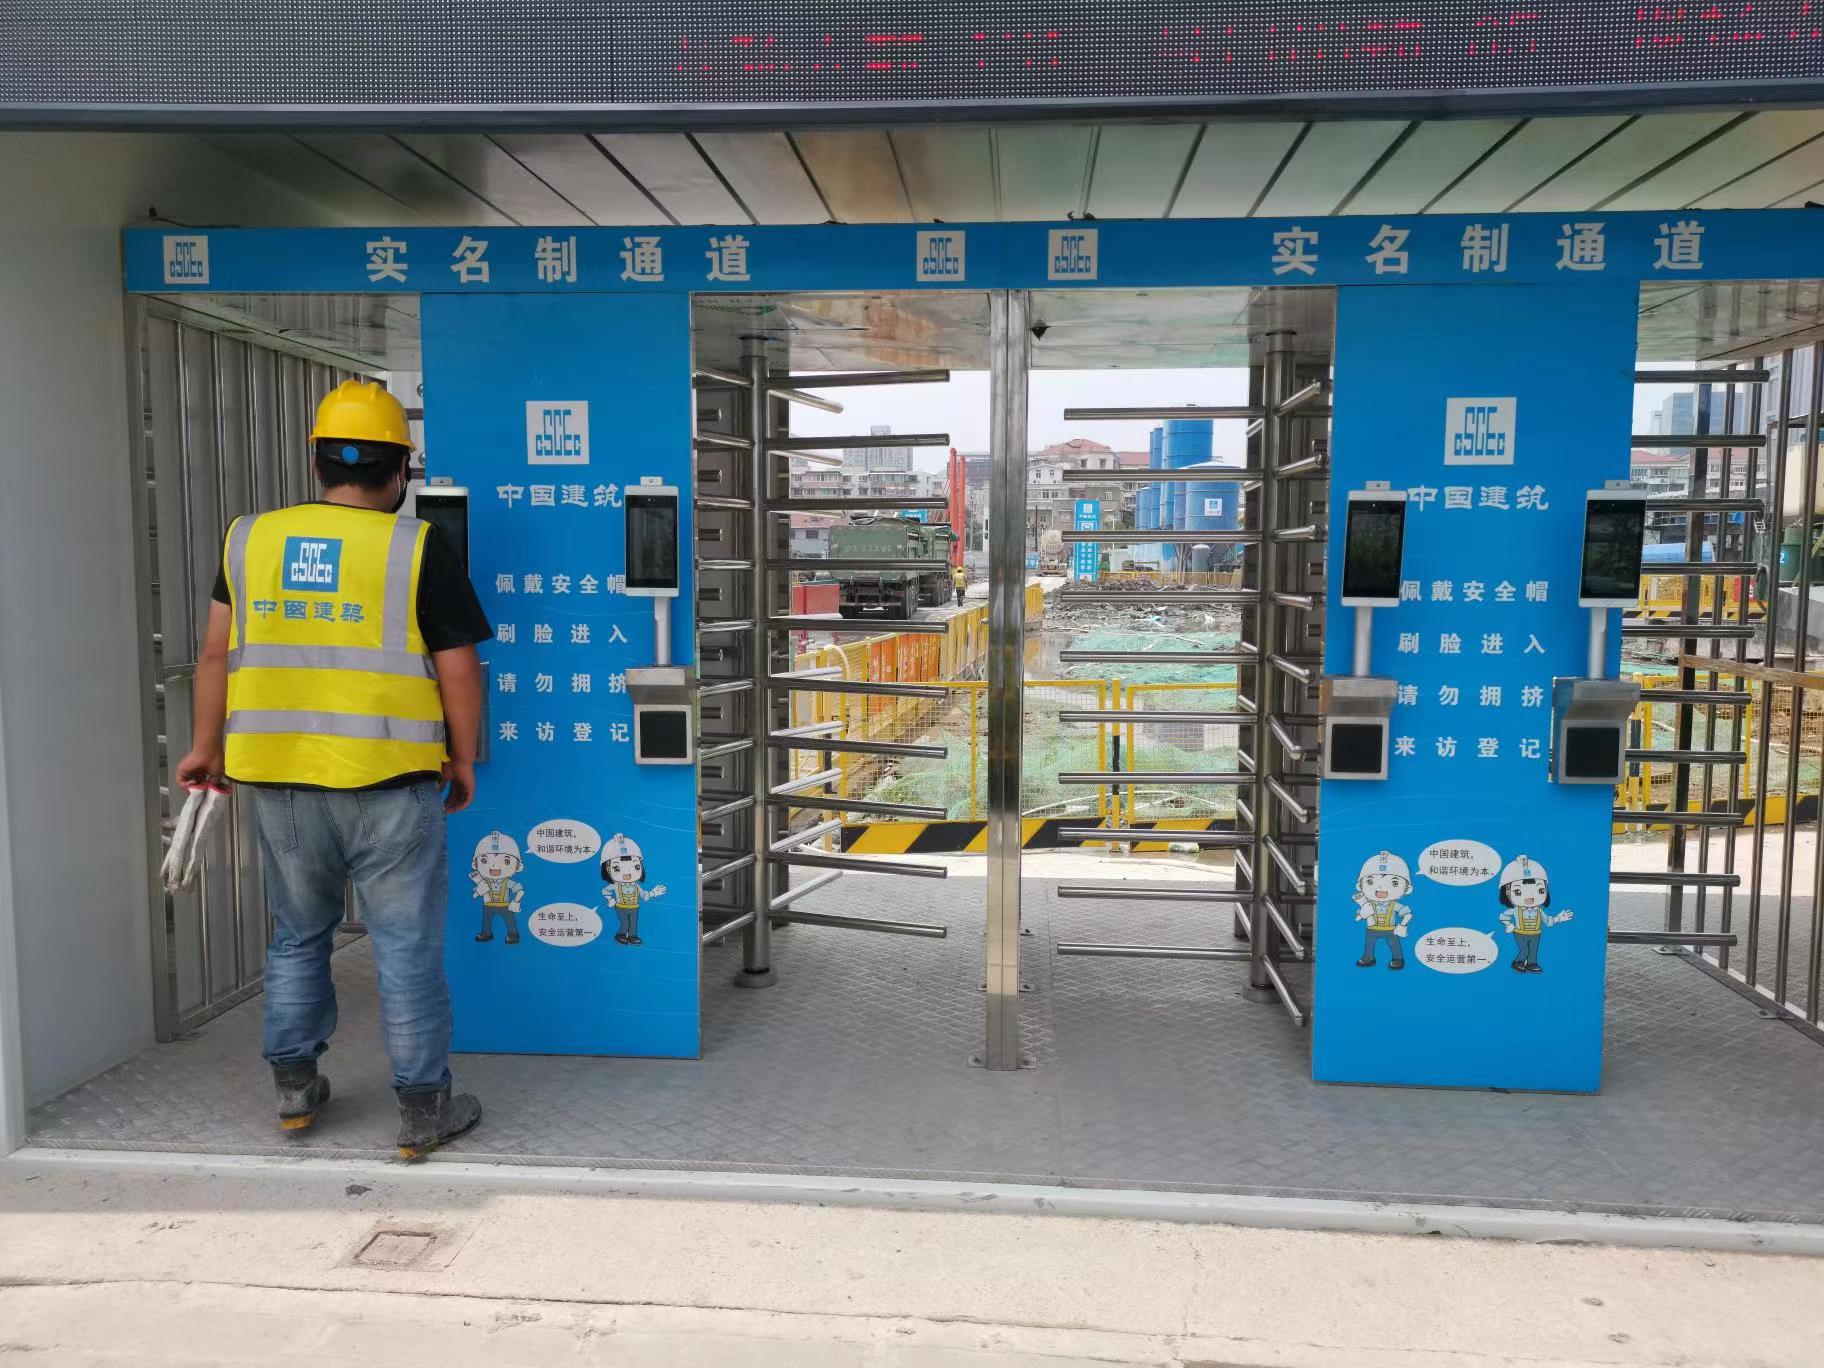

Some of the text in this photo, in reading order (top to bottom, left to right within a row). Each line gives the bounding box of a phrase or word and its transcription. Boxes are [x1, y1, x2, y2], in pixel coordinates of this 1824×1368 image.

[365, 233, 752, 284] 实名制通道
[1271, 220, 1705, 275] 实名制通道
[496, 482, 624, 509] 中国建筑
[1407, 484, 1550, 512] 中国建筑
[495, 573, 626, 595] 佩戴安全帽
[1399, 580, 1549, 603] 佩戴安全帽
[496, 623, 628, 645] 刷脸进入
[1398, 632, 1547, 655] 刷脸进入
[496, 672, 627, 694] 请勿拥挤
[1397, 684, 1545, 708] 请勿拥挤
[498, 721, 630, 743] 来访登记
[1394, 736, 1542, 760] 来访登记
